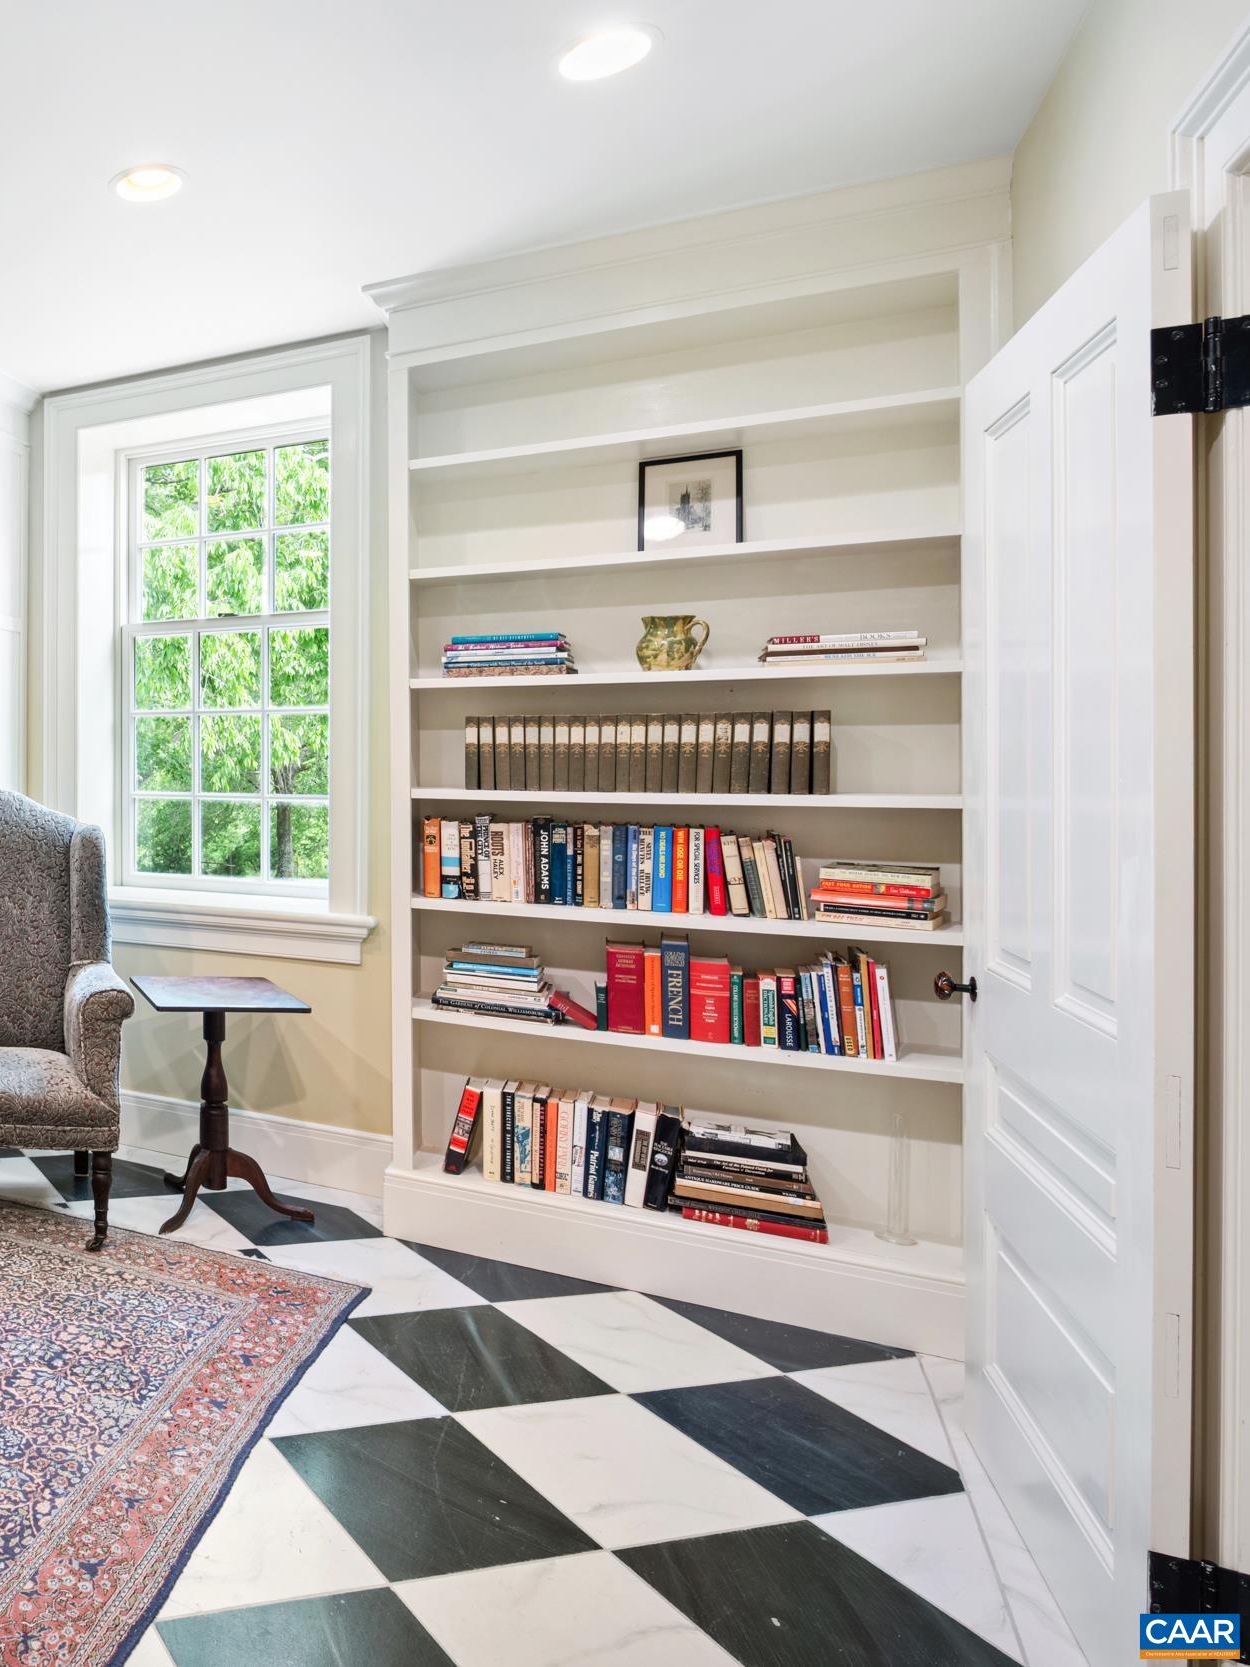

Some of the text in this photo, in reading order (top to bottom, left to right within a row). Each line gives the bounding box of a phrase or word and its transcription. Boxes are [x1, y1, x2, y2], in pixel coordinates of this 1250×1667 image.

[773, 635, 820, 644] MILLER'S
[490, 830, 505, 857] ROOTS
[676, 844, 684, 859] LOSE
[540, 829, 550, 890] JOHN ADAMS
[676, 859, 684, 869] OR
[693, 831, 701, 884] FOR SPECIAL SERVICES
[676, 869, 684, 881] DIE
[450, 999, 473, 1008] GARDENS
[481, 1003, 506, 1012] COLONIAL
[508, 1007, 545, 1017] WILLIAMSBURG
[667, 969, 683, 1026] FRENCH
[784, 1013, 794, 1047] LAROUSSE
[558, 1111, 569, 1142] GORKY
[587, 1150, 599, 1198] Patriot Games
[705, 1178, 731, 1187] HARDWARE
[744, 1184, 760, 1192] GUIDE
